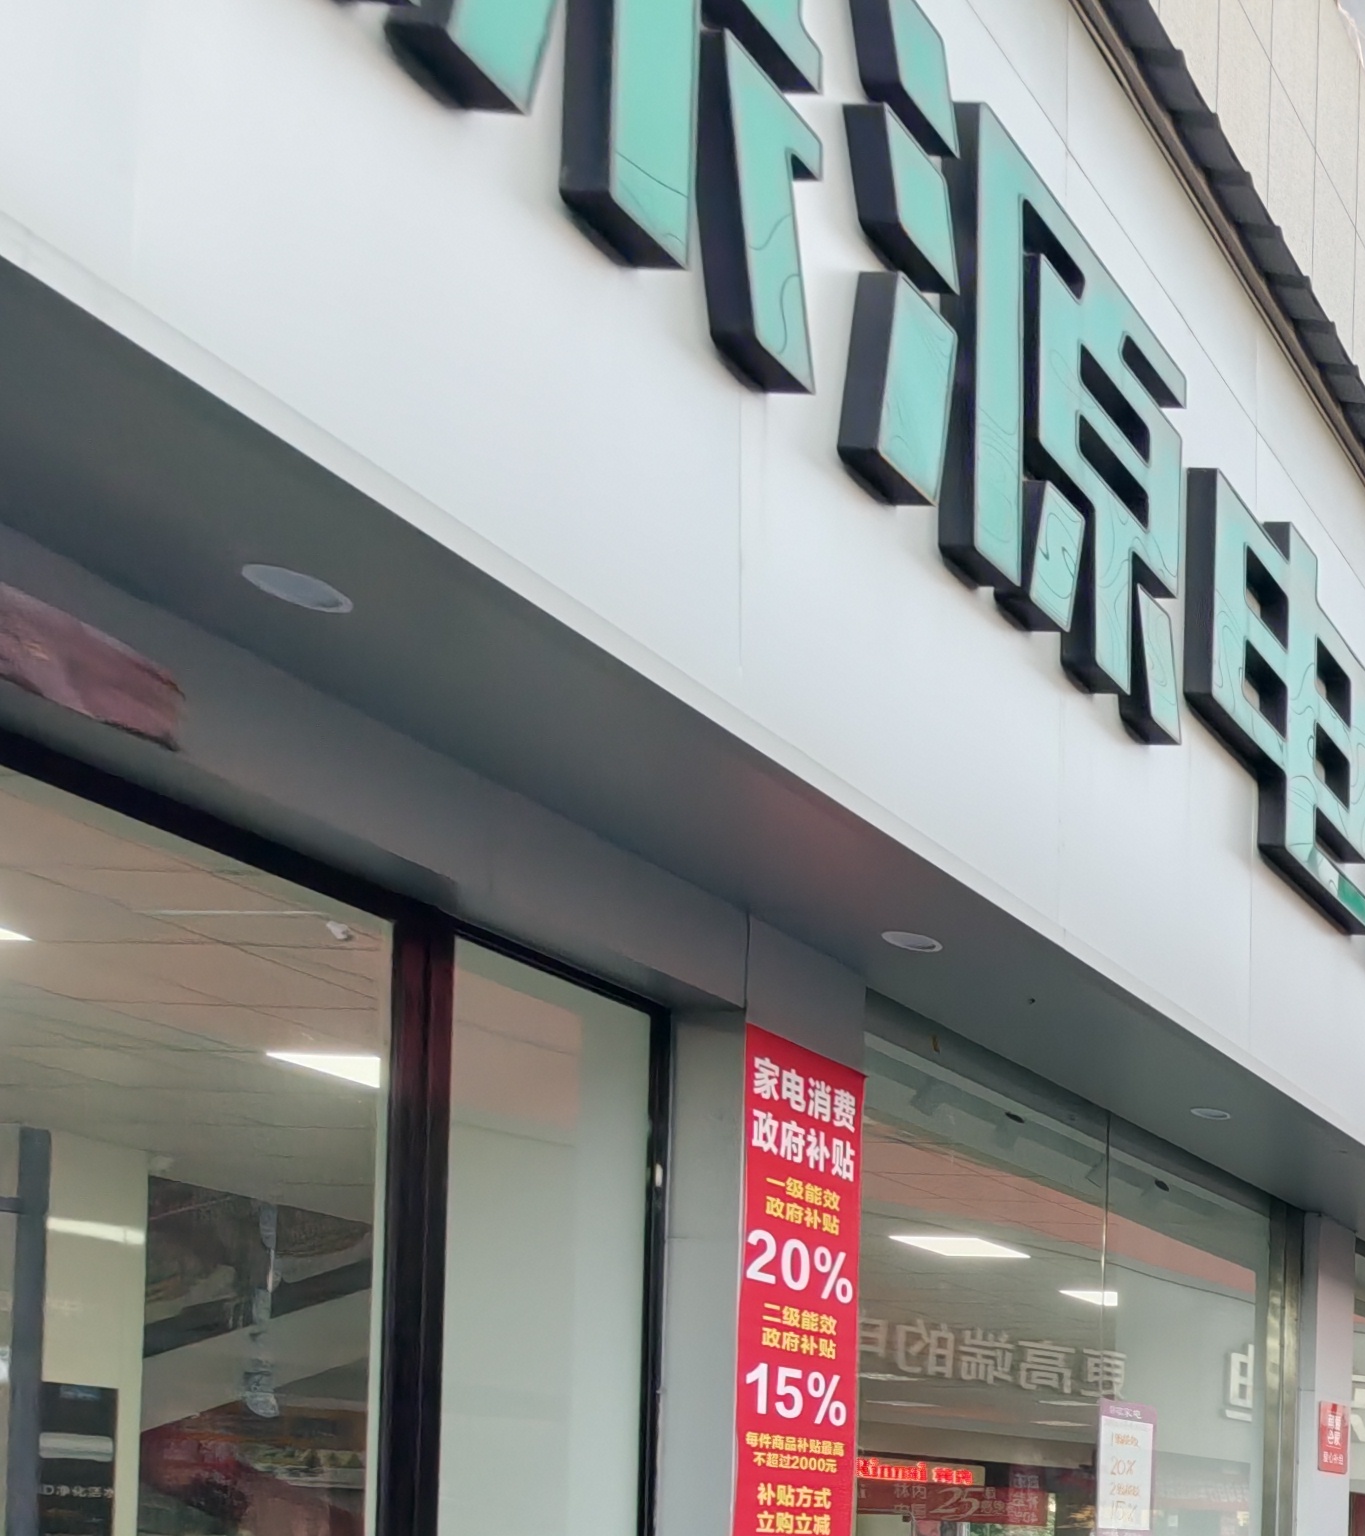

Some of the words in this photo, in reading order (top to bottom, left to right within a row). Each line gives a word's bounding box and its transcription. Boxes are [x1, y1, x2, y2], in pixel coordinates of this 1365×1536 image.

[753, 1056, 856, 1133] 家电消费
[752, 1108, 855, 1182] 政府补贴
[766, 1177, 840, 1211] 一级能效
[766, 1195, 840, 1235] 政府补贴
[746, 1229, 853, 1304] 20%
[762, 1302, 837, 1335] 二级能效
[762, 1327, 836, 1359] 政府补贴
[745, 1362, 847, 1427] 15%
[745, 1431, 845, 1457] 每件商品补贴最高
[753, 1451, 838, 1474] 不超过2000元
[1110, 1456, 1137, 1476] 20%
[757, 1483, 832, 1509] 补贴方式
[756, 1511, 831, 1535] 立购立减
